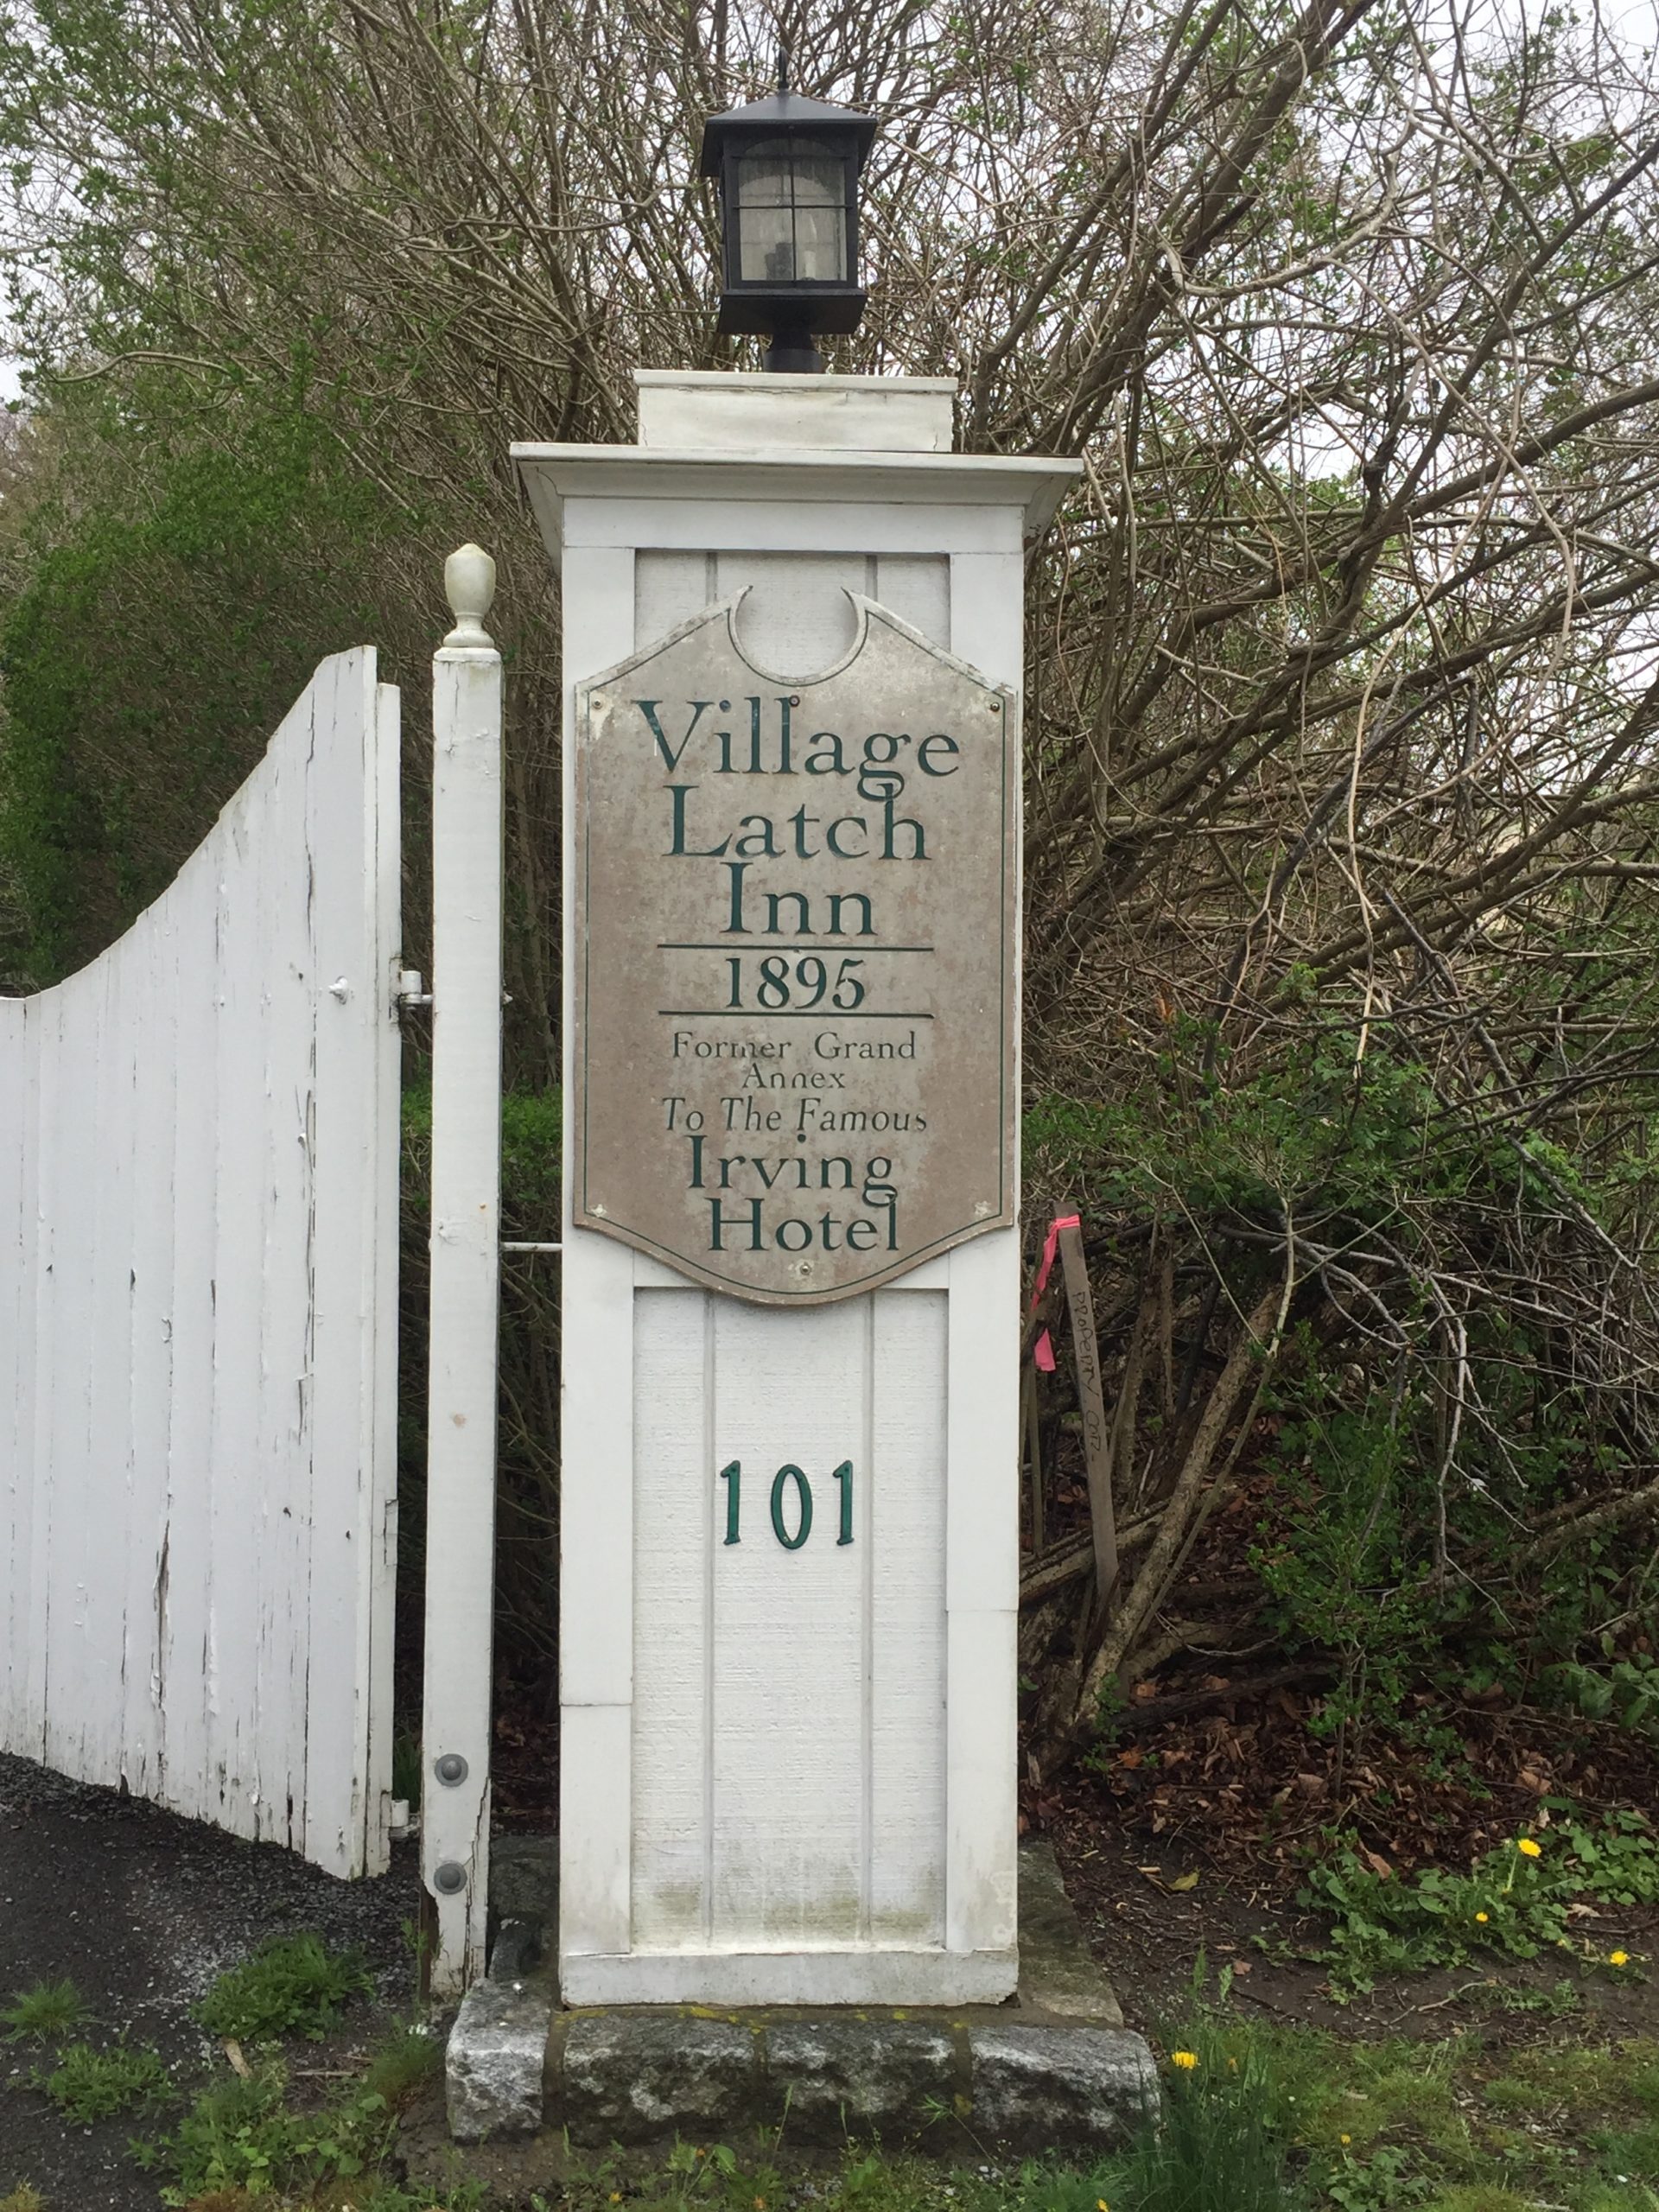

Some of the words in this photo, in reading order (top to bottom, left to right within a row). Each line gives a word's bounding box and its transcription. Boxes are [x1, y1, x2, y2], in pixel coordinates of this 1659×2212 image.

[631, 695, 960, 802] Village
[661, 782, 932, 861] Latch
[719, 861, 879, 936] Inn
[724, 956, 866, 1010] 1895
[672, 1031, 792, 1060] Former
[813, 1031, 917, 1060] Grand
[741, 1063, 846, 1089] Annex
[662, 1096, 705, 1132] To
[720, 1095, 782, 1132] The
[795, 1096, 928, 1133] Famous
[685, 1133, 898, 1208] Irving
[705, 1193, 900, 1252] Hotel
[720, 1459, 855, 1550] 101
